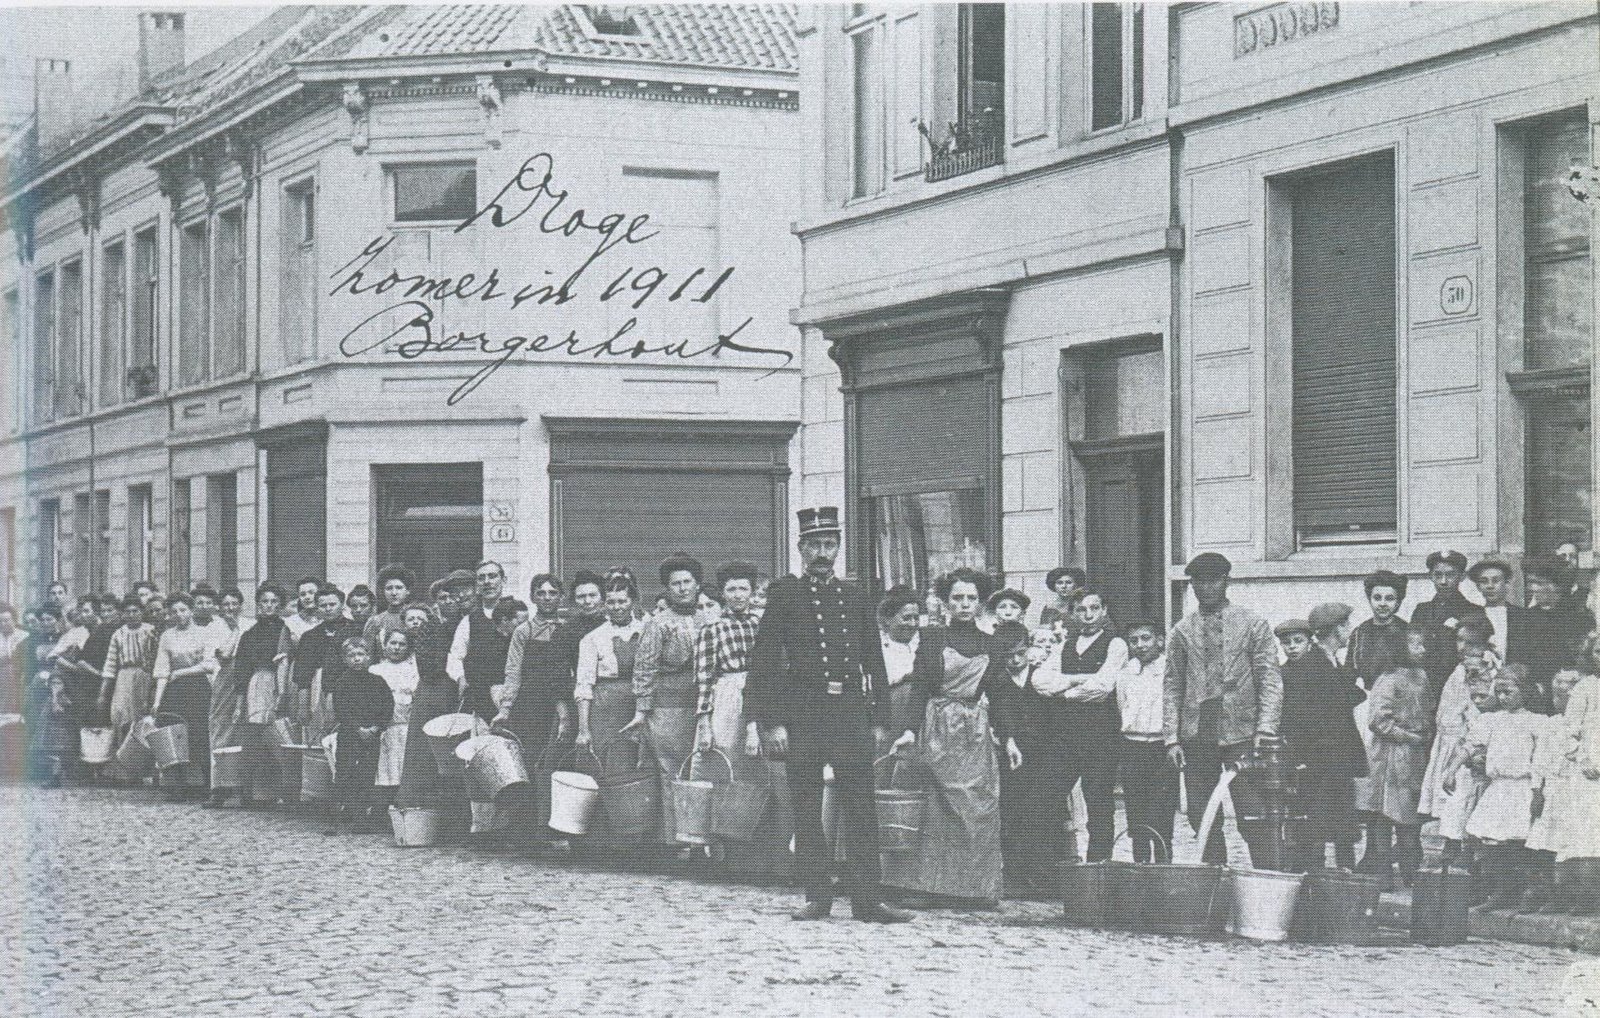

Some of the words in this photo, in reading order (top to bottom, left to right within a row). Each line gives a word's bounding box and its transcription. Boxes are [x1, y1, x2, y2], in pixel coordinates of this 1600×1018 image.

[454, 153, 661, 298] Droge
[511, 269, 577, 306] in
[599, 266, 735, 309] 1911
[339, 300, 794, 406] Borgerhout
